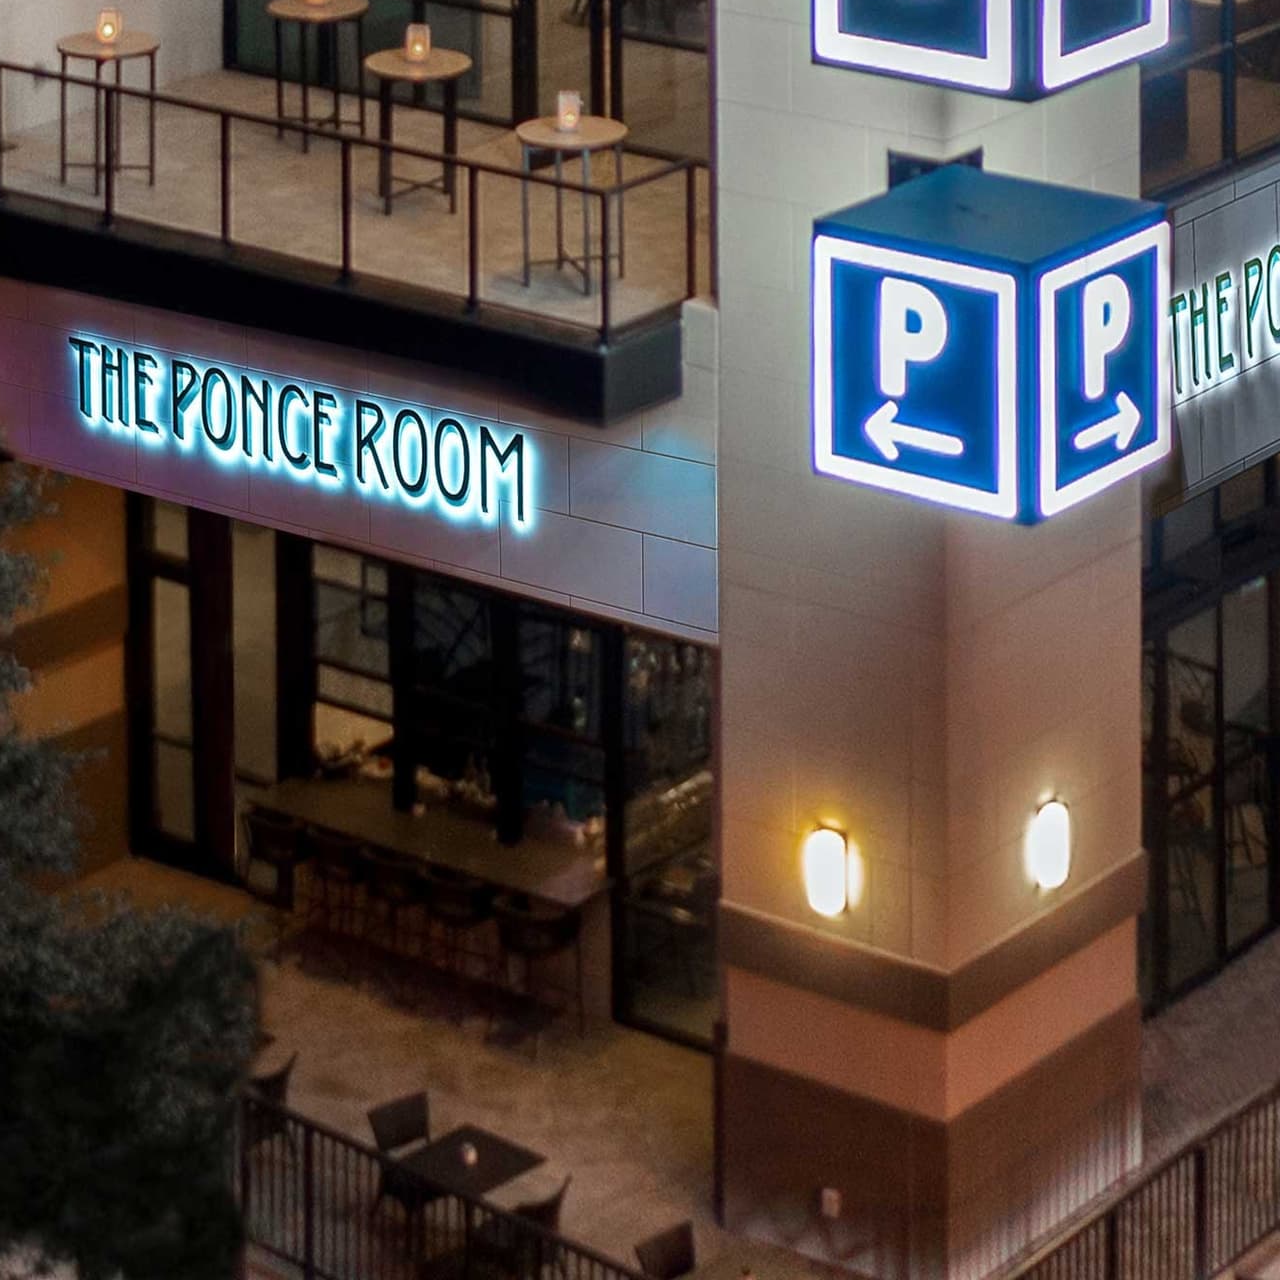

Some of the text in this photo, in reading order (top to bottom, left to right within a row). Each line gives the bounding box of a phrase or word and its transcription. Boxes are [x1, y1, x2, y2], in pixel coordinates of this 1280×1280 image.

[877, 275, 950, 399] P
[1082, 272, 1132, 402] P
[1169, 270, 1235, 396] THE
[68, 336, 526, 524] THE PONCE ROOM
